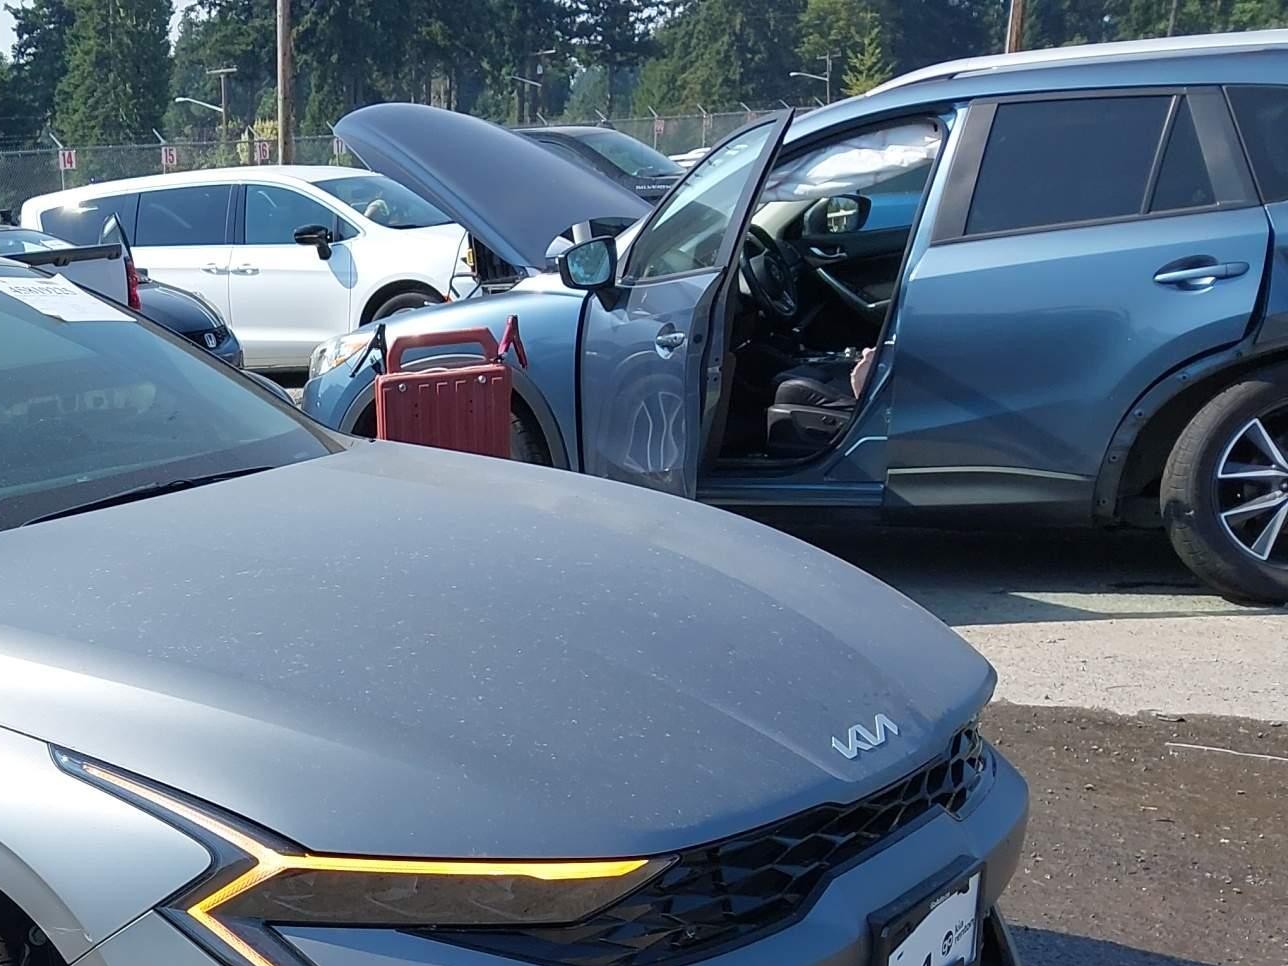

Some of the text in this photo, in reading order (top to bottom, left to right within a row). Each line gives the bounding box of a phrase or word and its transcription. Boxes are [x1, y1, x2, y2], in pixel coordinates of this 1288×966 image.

[164, 148, 175, 164] 15
[259, 142, 269, 159] 16
[62, 151, 73, 168] 14
[831, 713, 899, 760] KIA
